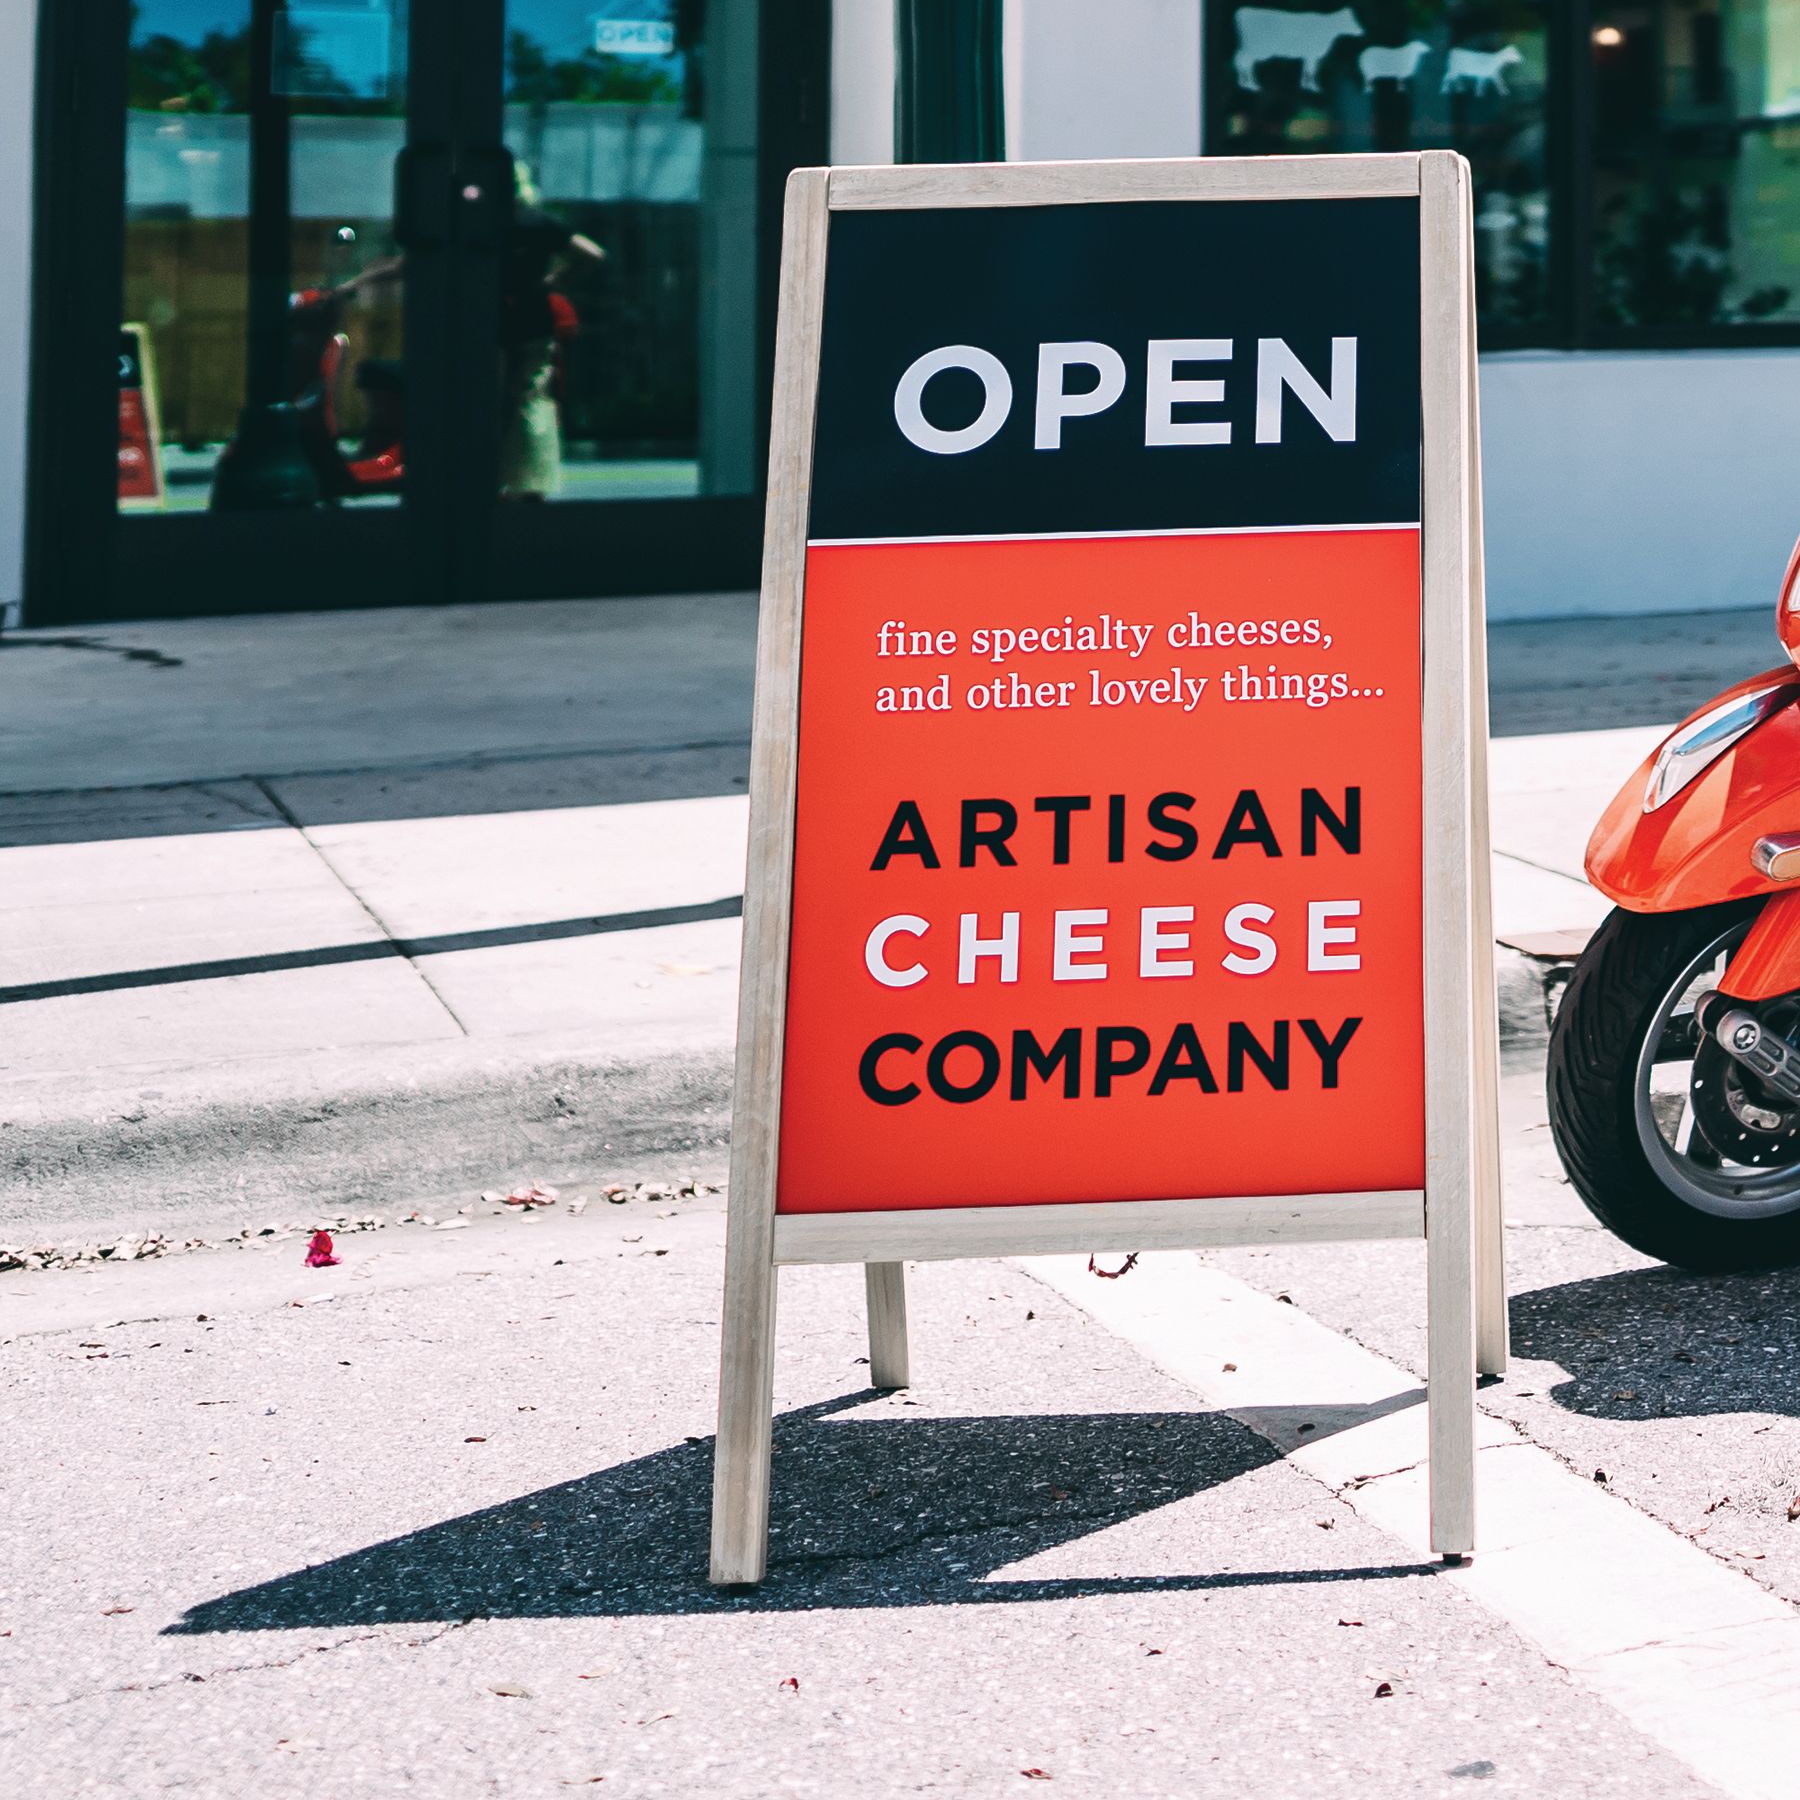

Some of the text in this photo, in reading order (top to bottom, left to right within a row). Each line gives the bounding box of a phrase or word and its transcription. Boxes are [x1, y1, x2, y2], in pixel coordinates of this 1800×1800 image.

[894, 336, 1358, 454] OPEN
[876, 611, 1333, 662] fine specialty cheeses,
[875, 664, 1384, 712] and other lovely things...
[869, 785, 1361, 871] ARTISAN
[864, 899, 1361, 988] CHEESE
[858, 1016, 1363, 1107] COMPANY
